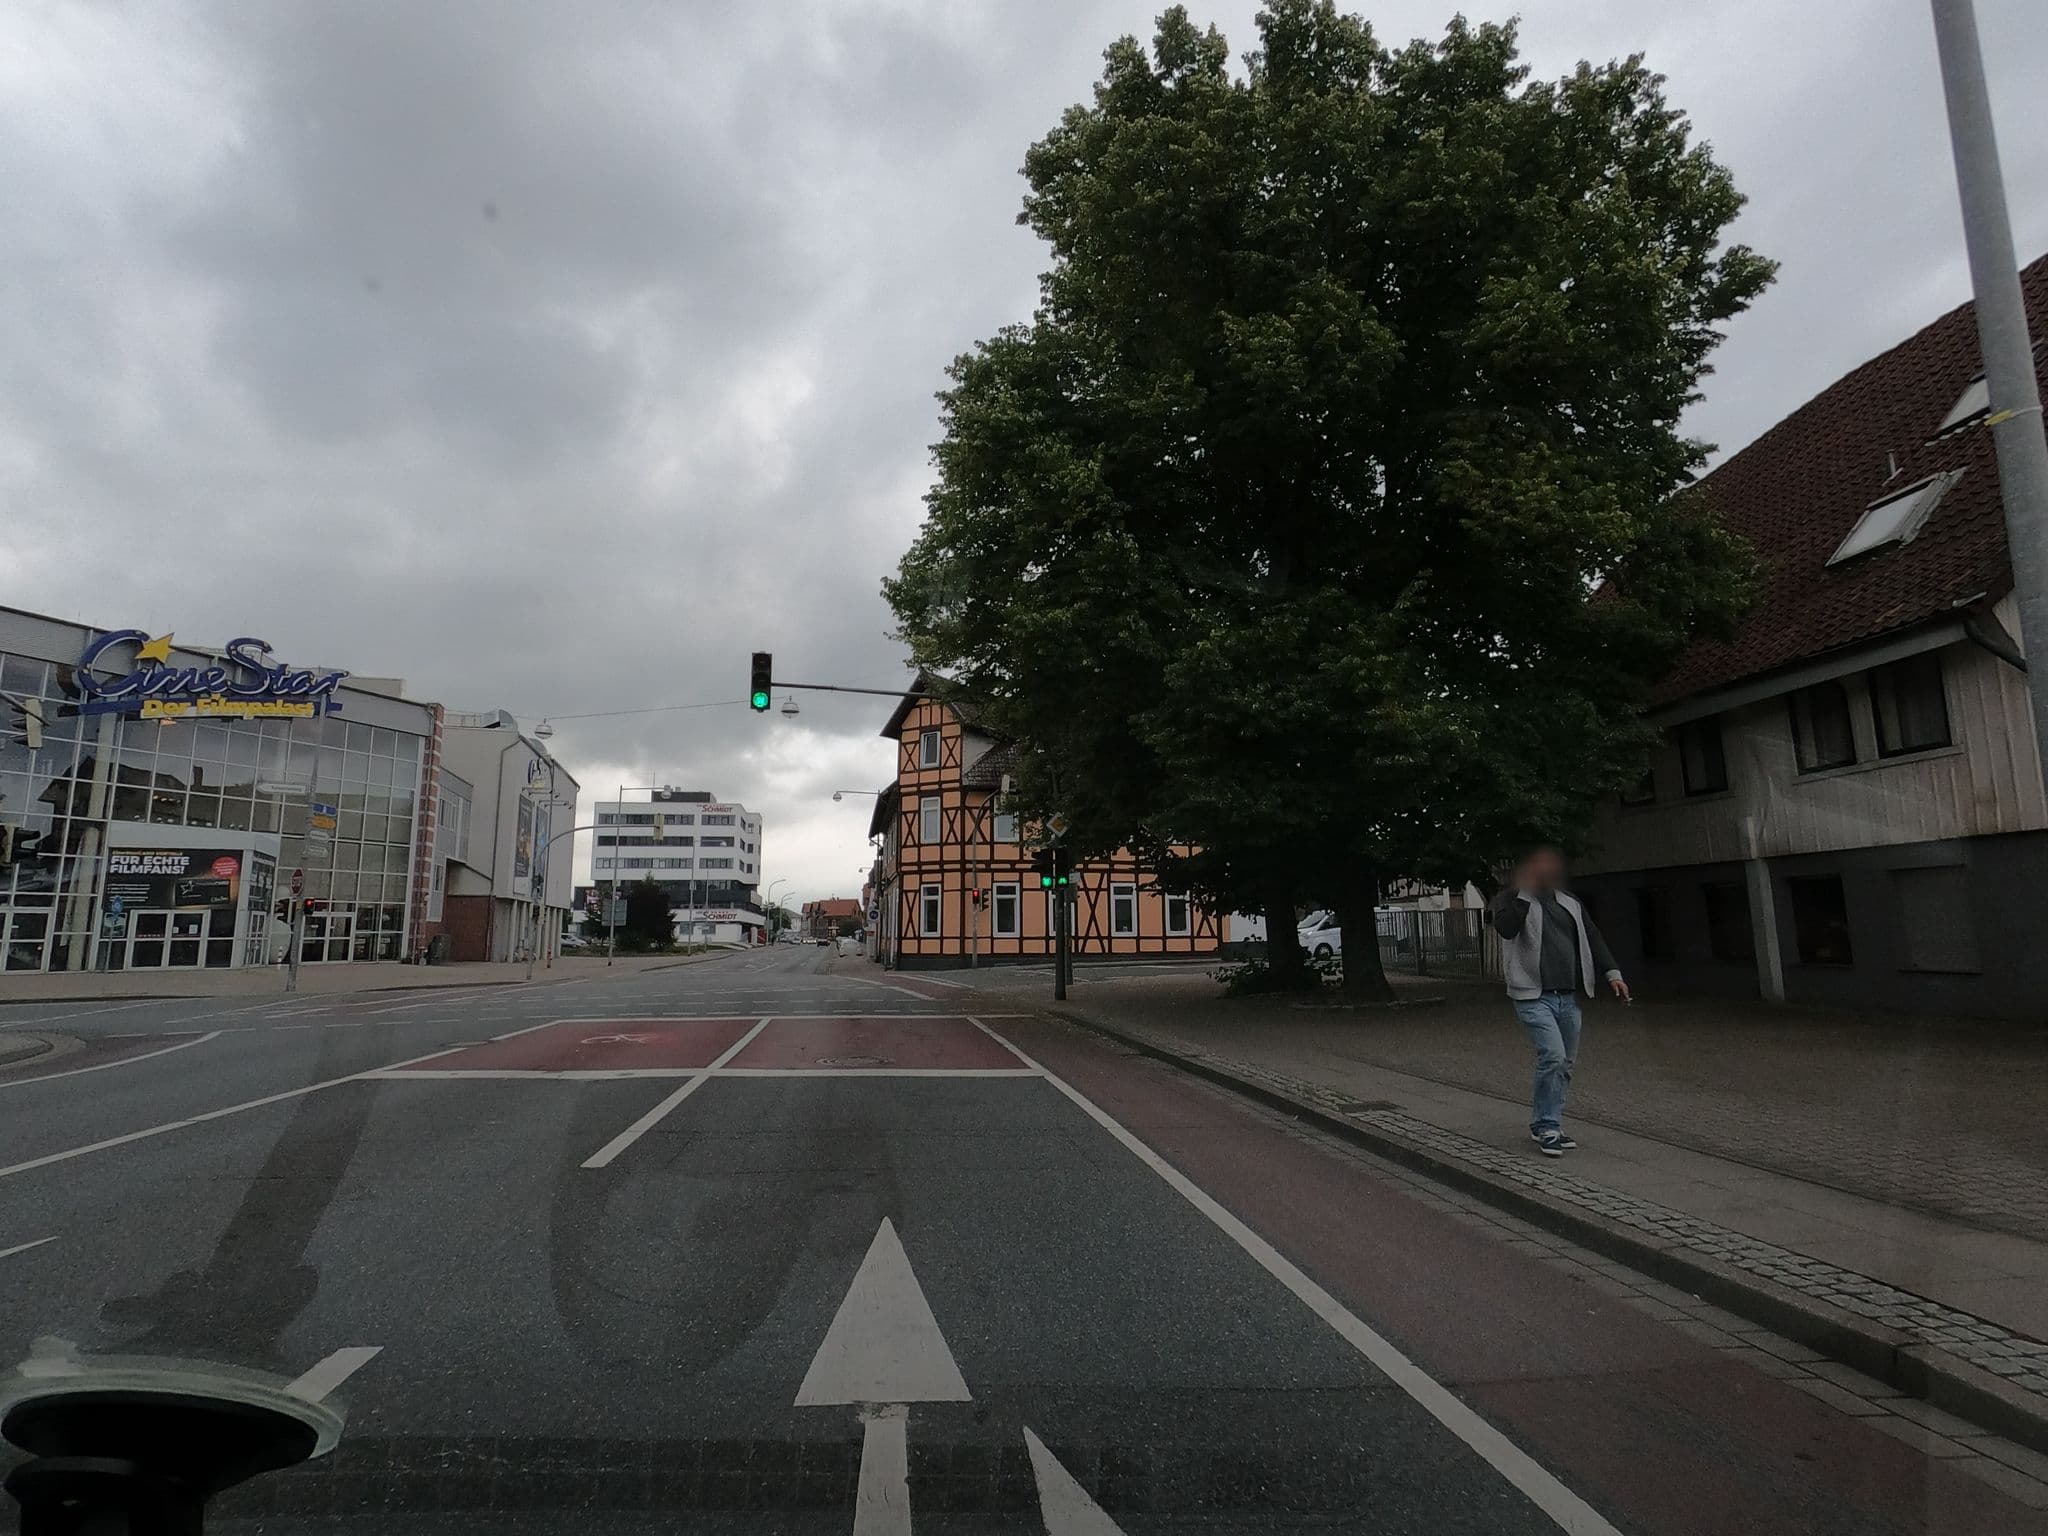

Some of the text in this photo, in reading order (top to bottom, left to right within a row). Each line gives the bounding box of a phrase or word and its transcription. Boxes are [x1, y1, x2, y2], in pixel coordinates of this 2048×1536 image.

[77, 629, 351, 697] CineStar
[143, 693, 315, 719] Der Filmpalast
[143, 855, 190, 865] ECHTE
[109, 864, 185, 875] FILMFANS!
[703, 910, 738, 920] SCHMIDT
